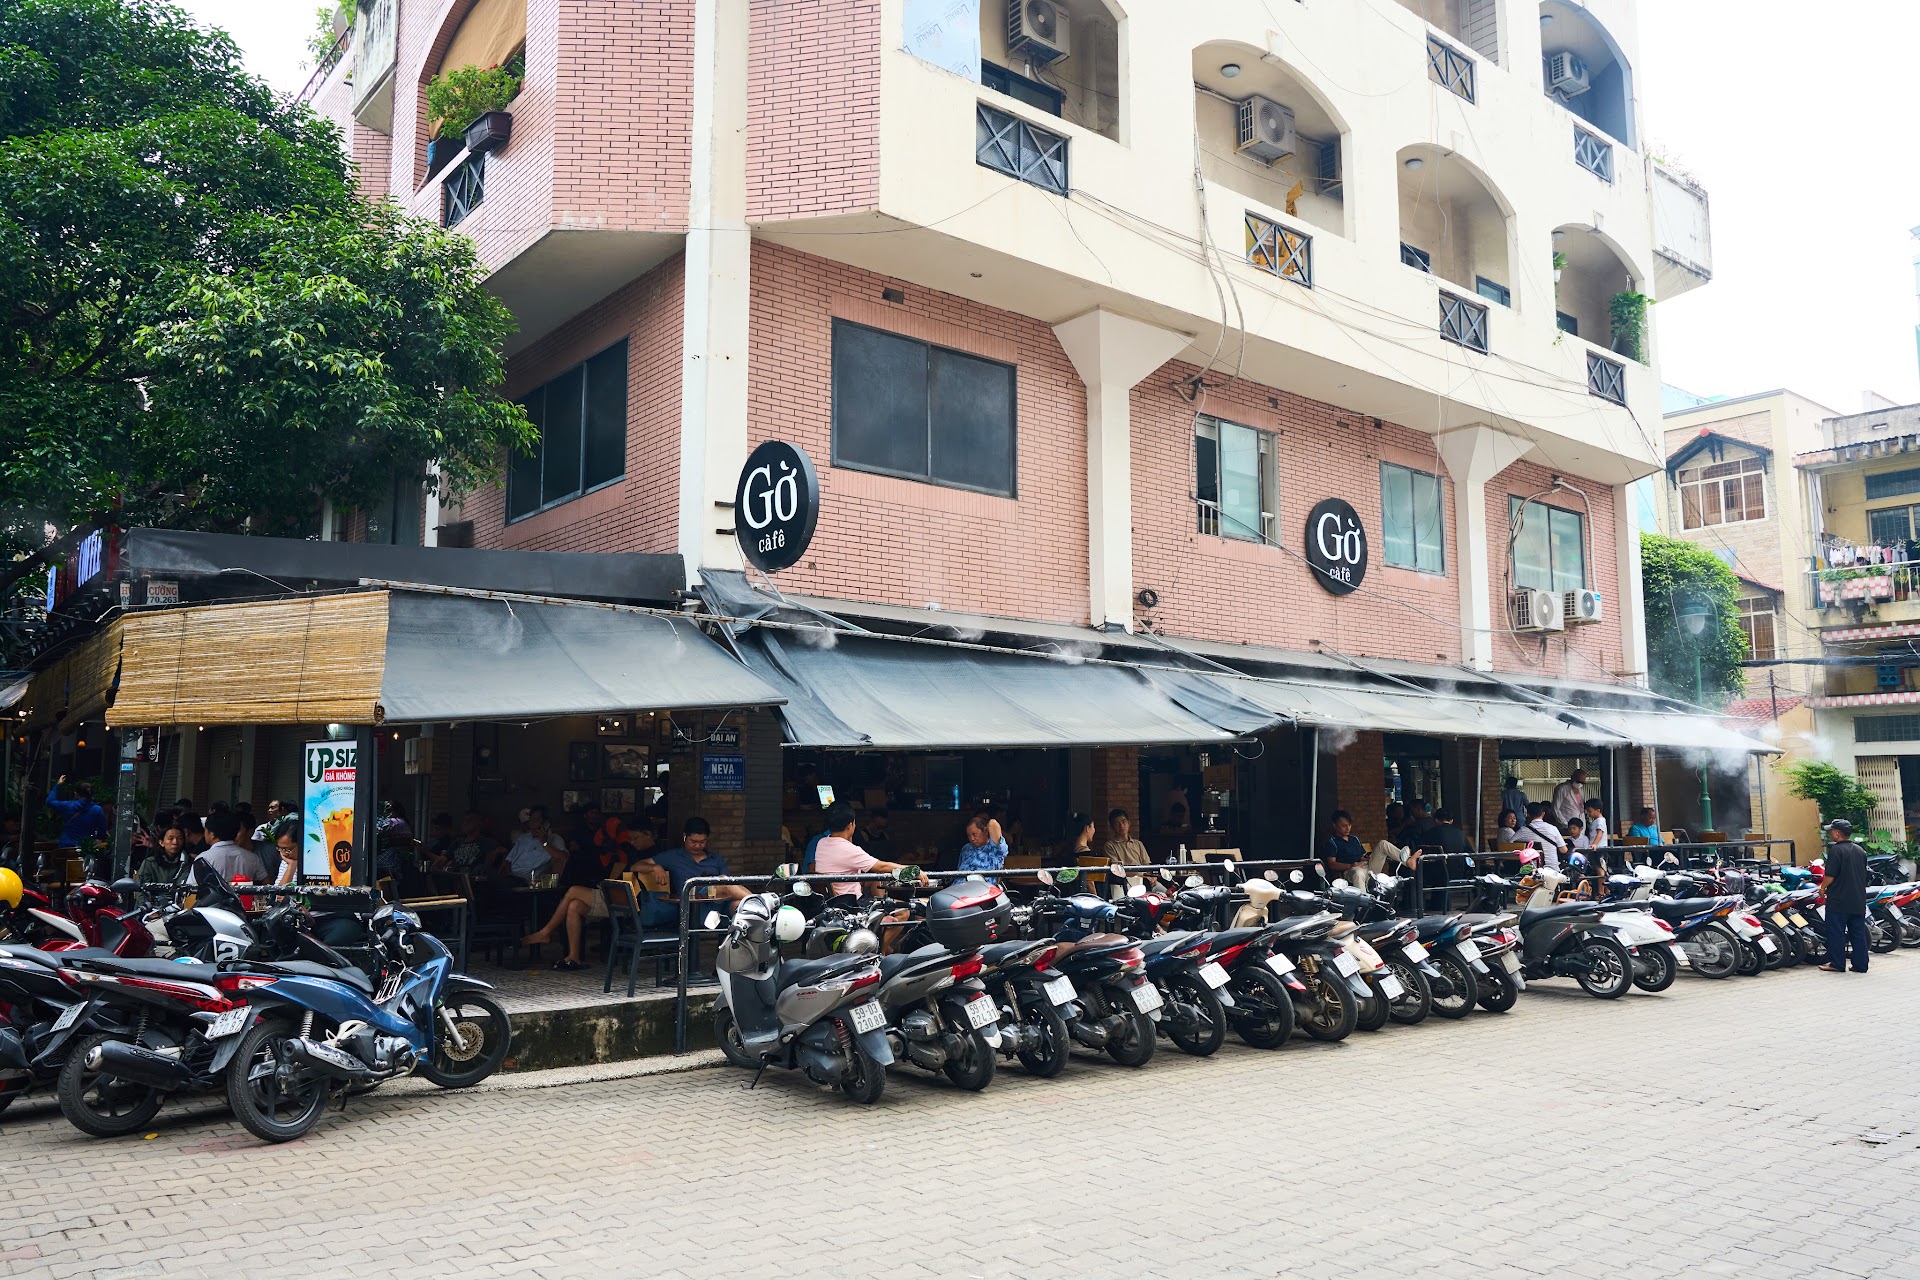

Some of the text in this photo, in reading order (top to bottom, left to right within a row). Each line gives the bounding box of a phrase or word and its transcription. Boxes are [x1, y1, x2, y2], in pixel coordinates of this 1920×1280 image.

[743, 460, 798, 529] Gờ
[758, 529, 786, 553] càfê
[1317, 512, 1361, 565] Gờ
[148, 584, 178, 596] CƯỜNG
[146, 596, 178, 604] 70.263
[325, 769, 356, 781] GIÁ KHÔNG
[711, 763, 735, 775] NEVA
[336, 848, 351, 863] Gờ
[854, 1003, 878, 1020] 59-D3
[968, 999, 990, 1015] 59-F1
[857, 1013, 885, 1032] 230.88
